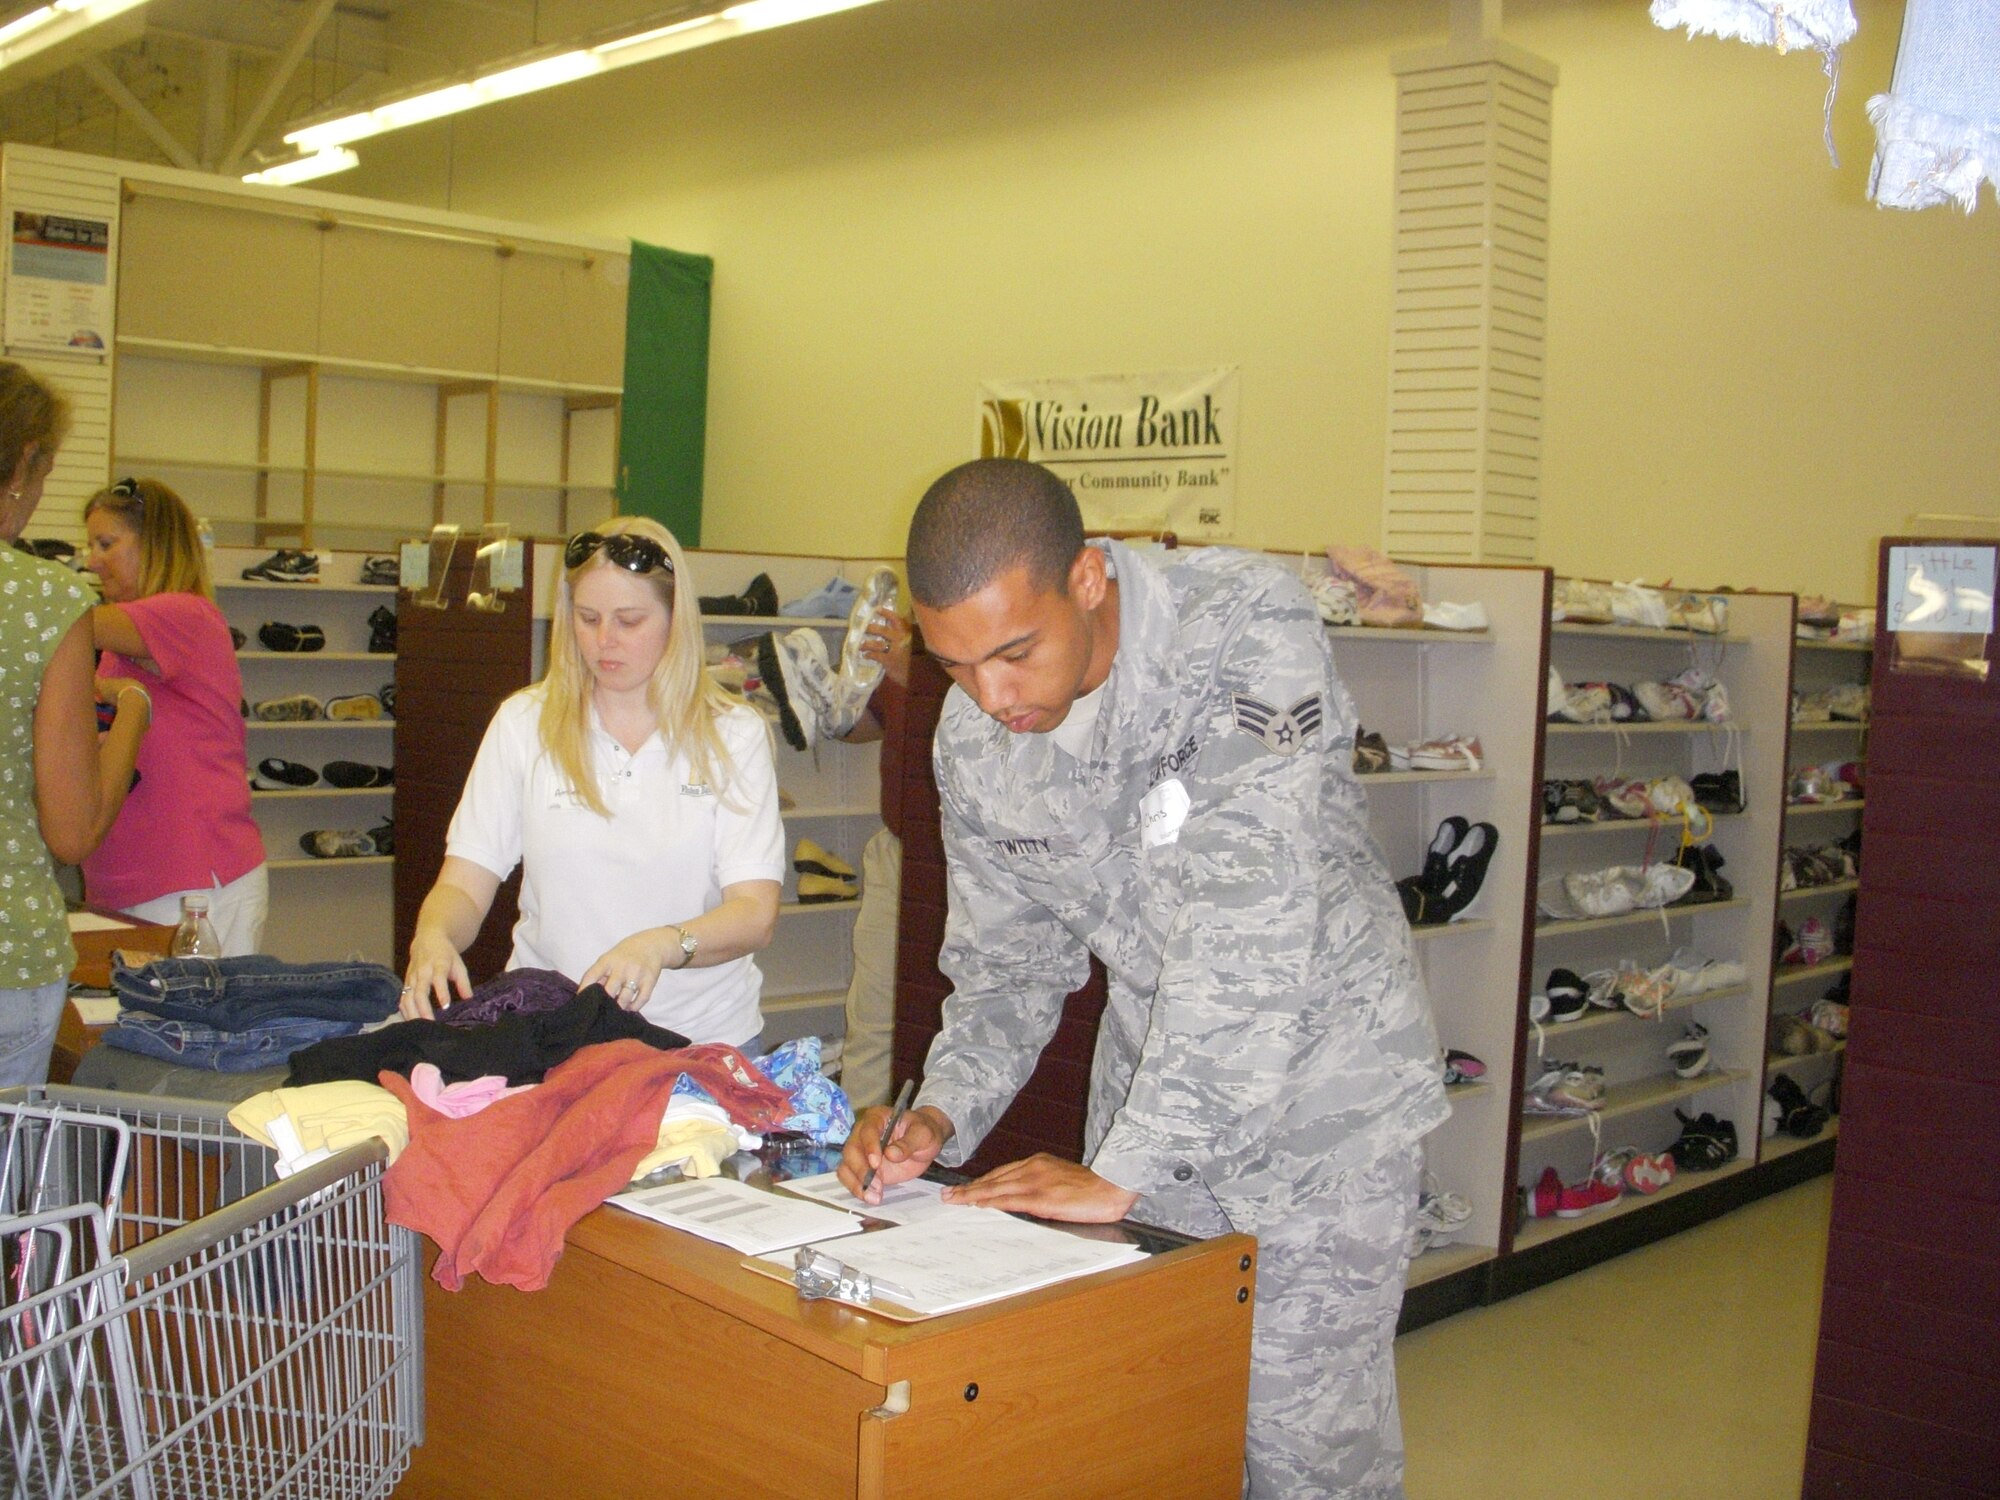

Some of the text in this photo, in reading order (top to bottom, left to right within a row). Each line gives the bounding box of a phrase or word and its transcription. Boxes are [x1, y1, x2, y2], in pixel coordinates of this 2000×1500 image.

[1034, 394, 1222, 451] Vision Bank
[1080, 470, 1171, 493] Community
[994, 837, 1052, 856] TWITTY
